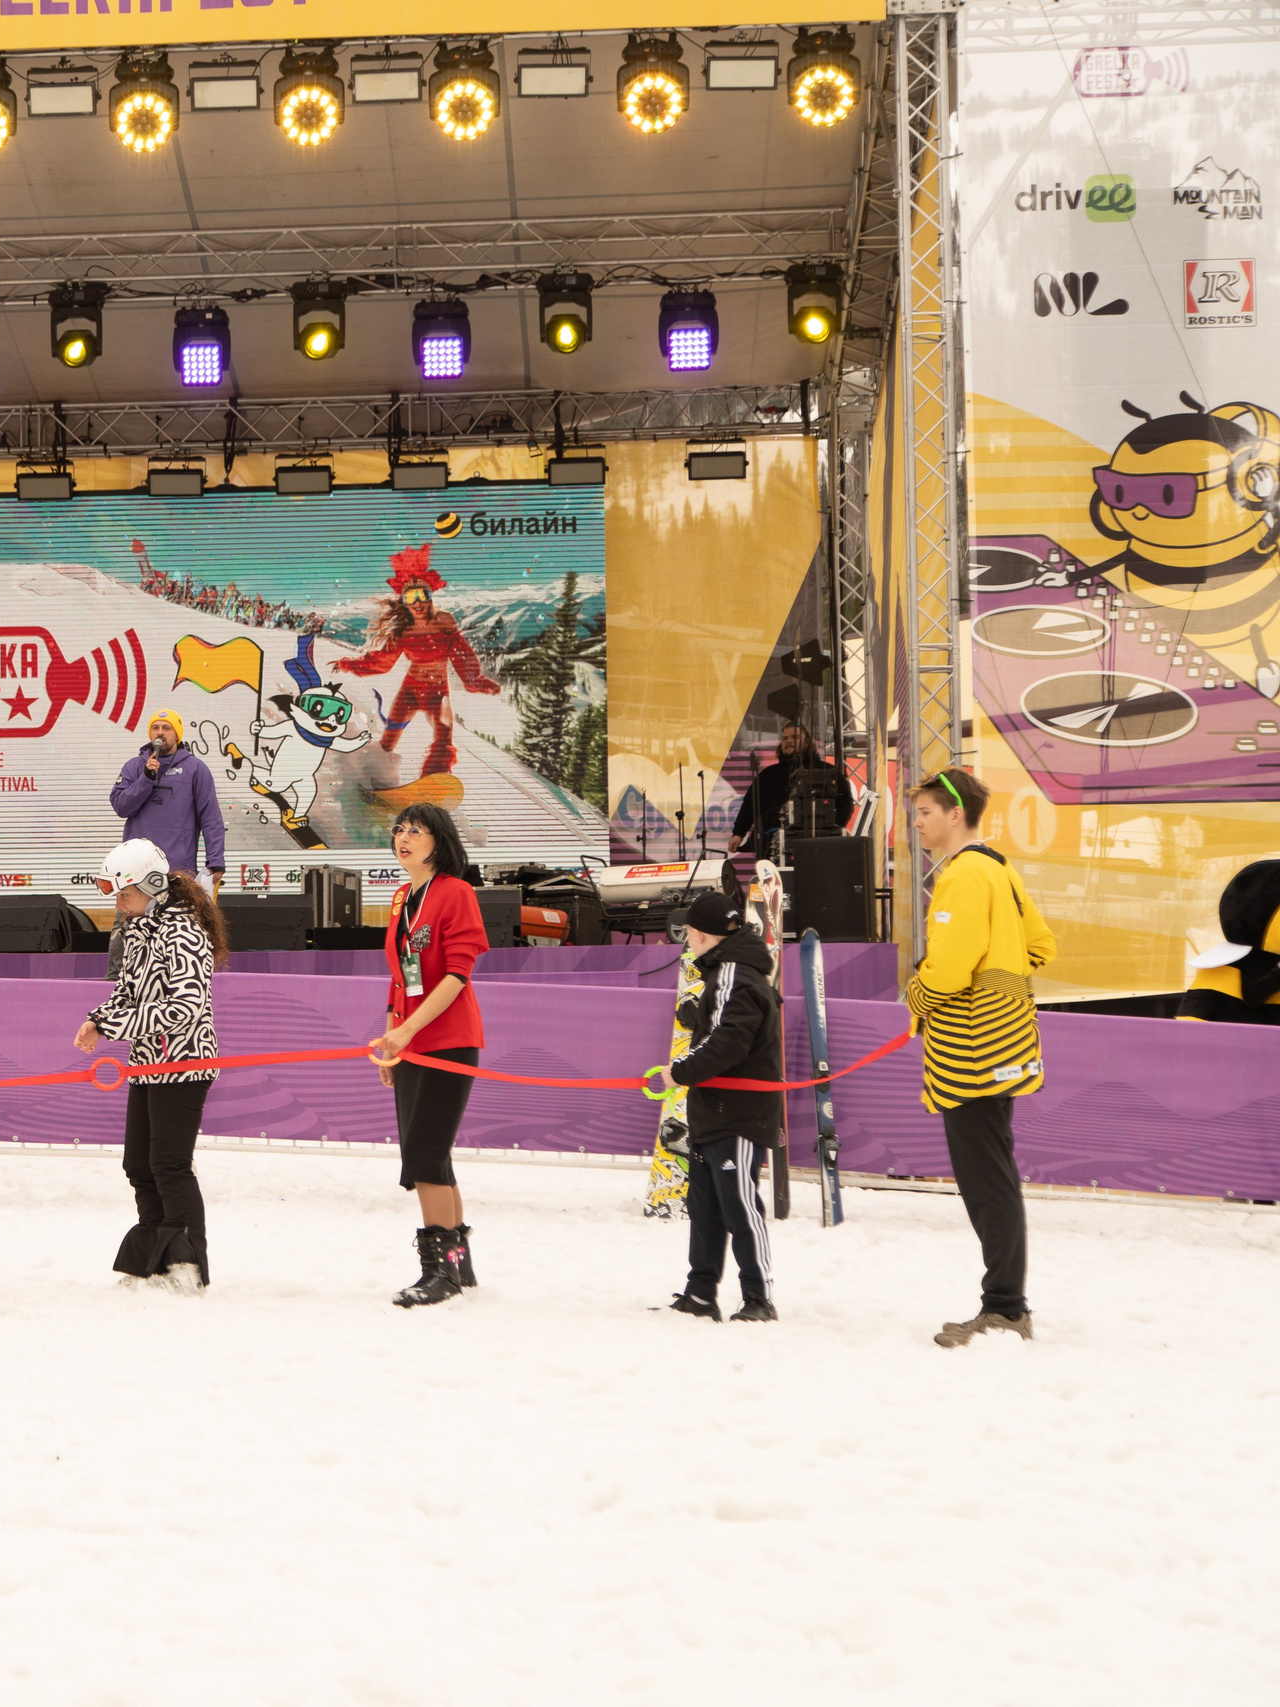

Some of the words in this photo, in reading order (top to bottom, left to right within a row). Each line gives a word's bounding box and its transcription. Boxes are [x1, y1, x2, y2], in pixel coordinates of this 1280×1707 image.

[1014, 182, 1136, 213] drivee
[1173, 188, 1261, 205] MOUNTAIN
[1222, 206, 1263, 220] MAN
[1188, 315, 1253, 326] ROSTIC'S
[470, 511, 577, 536] билайн
[71, 872, 97, 885] driv
[368, 868, 400, 878] СДС
